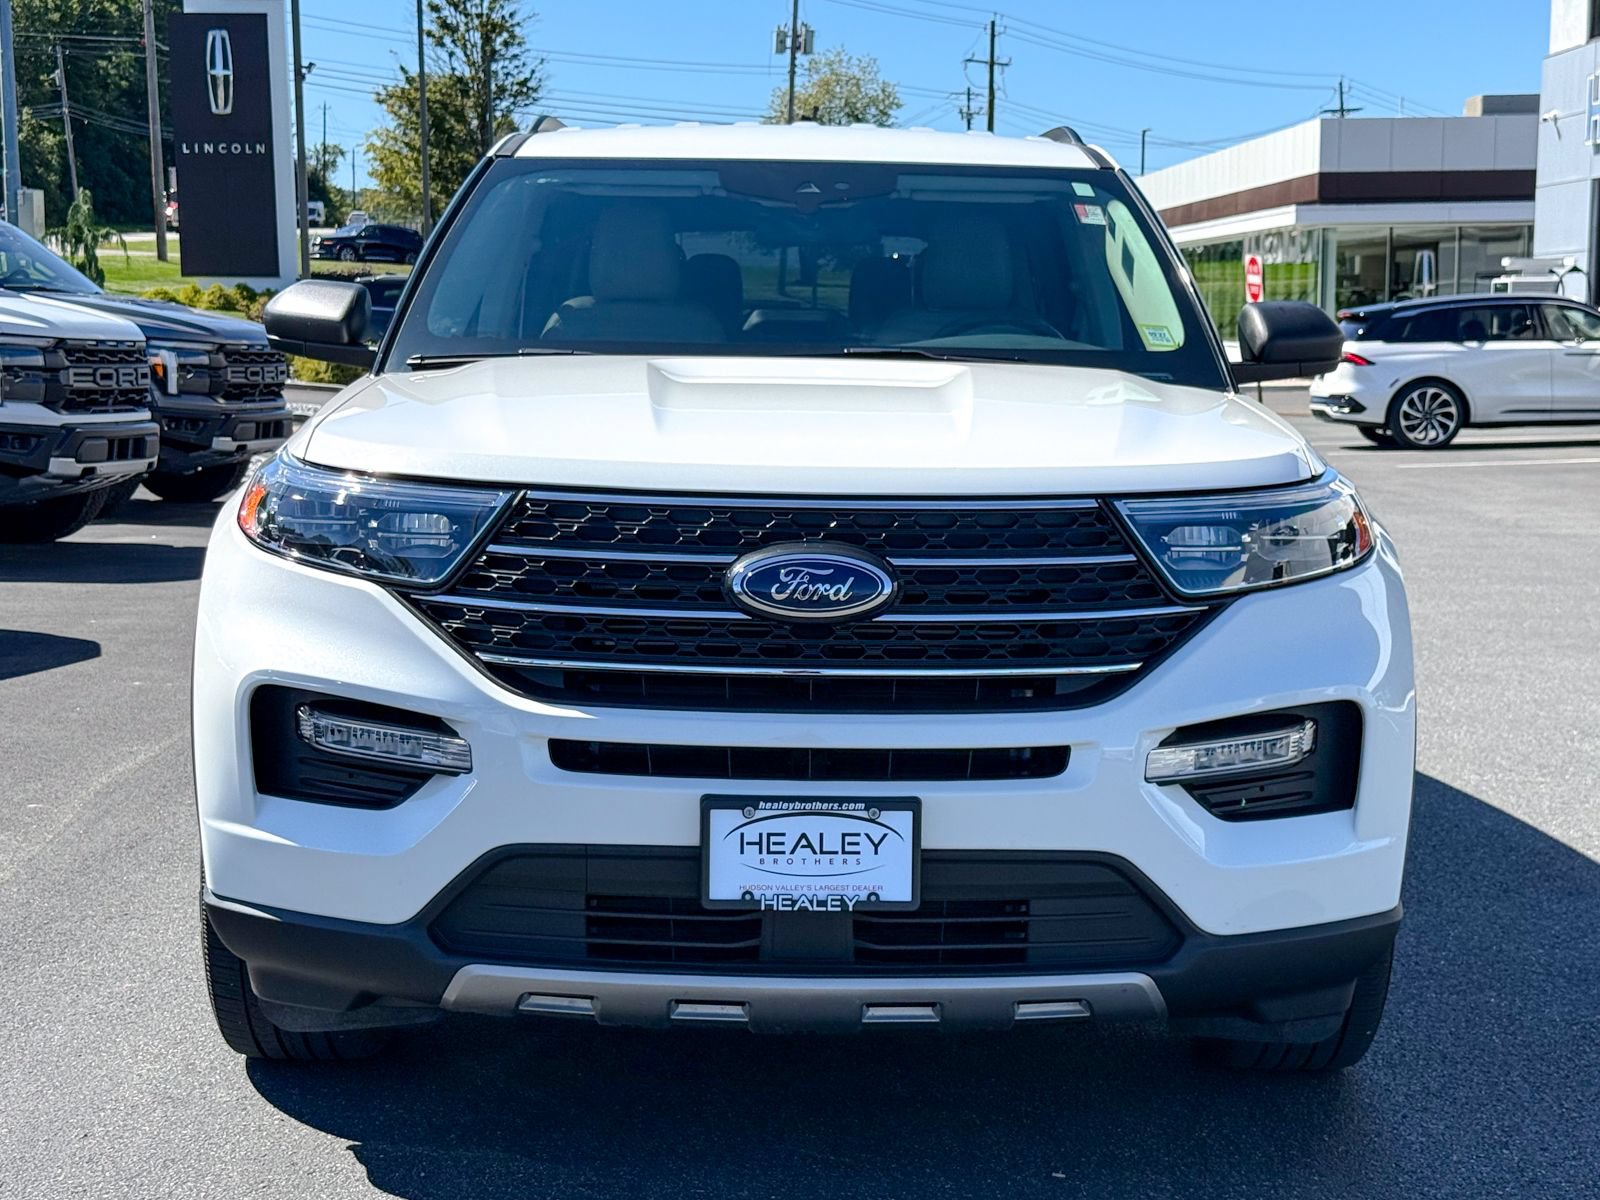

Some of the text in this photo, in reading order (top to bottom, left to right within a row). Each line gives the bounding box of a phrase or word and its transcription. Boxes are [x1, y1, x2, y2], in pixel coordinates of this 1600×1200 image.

[182, 143, 266, 154] LINCOLN
[69, 367, 151, 387] FORD
[227, 366, 288, 382] FORD
[771, 566, 855, 602] Ford
[758, 801, 866, 811] healeybrothers.com
[740, 832, 889, 855] HEALEY
[760, 894, 860, 912] HEALEY
